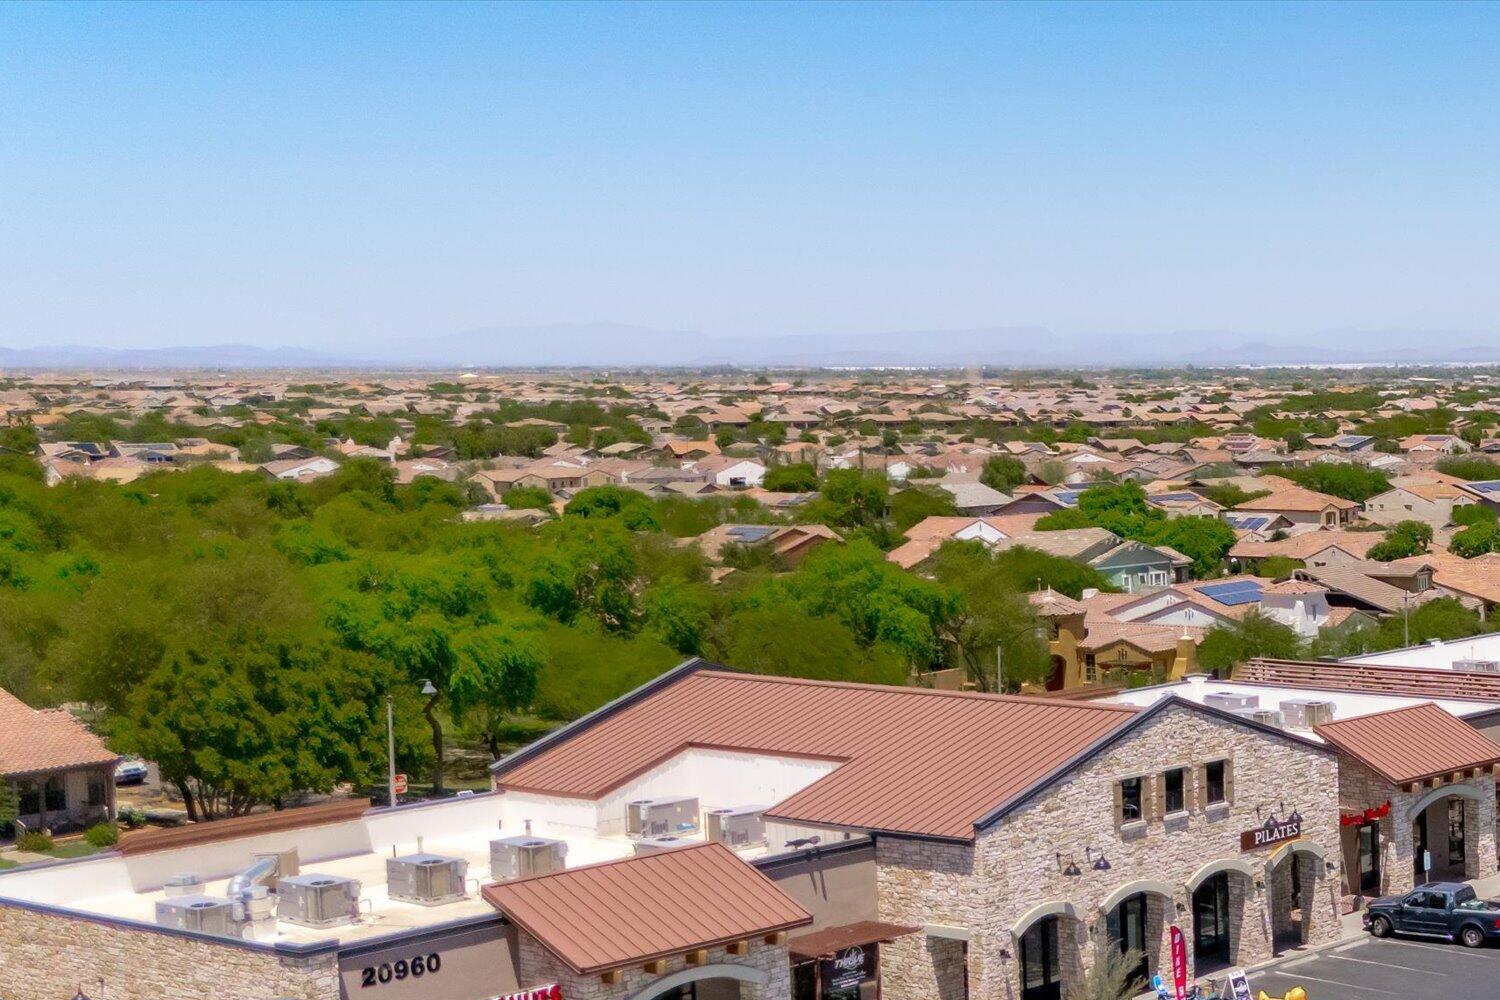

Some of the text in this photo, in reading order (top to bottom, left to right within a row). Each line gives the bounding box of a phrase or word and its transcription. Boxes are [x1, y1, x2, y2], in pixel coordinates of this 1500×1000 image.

[1254, 823, 1299, 845] PILATES
[361, 953, 442, 988] 20960
[1174, 933, 1182, 979] BIKE
